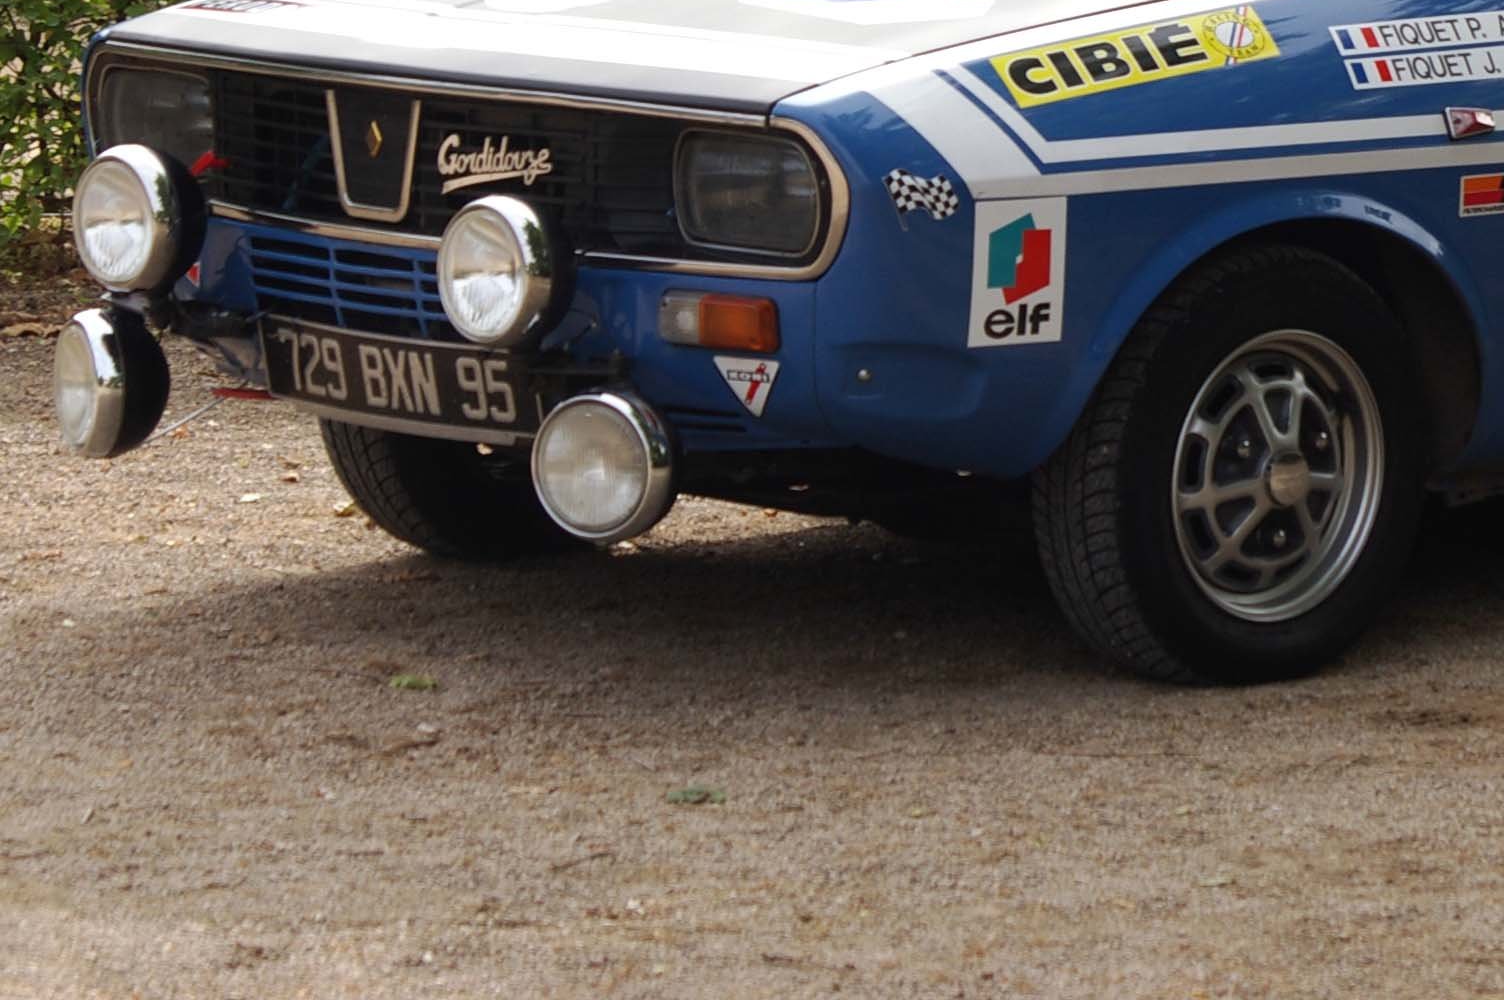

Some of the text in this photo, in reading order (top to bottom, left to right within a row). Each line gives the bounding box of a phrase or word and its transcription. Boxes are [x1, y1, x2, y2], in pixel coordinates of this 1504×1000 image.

[1378, 18, 1461, 47] FIQUET
[1466, 16, 1487, 40] P.
[1392, 53, 1474, 81] FIQUET
[1484, 51, 1501, 75] J.
[983, 300, 1051, 341] elf
[276, 327, 517, 424] 729 BXN 95
